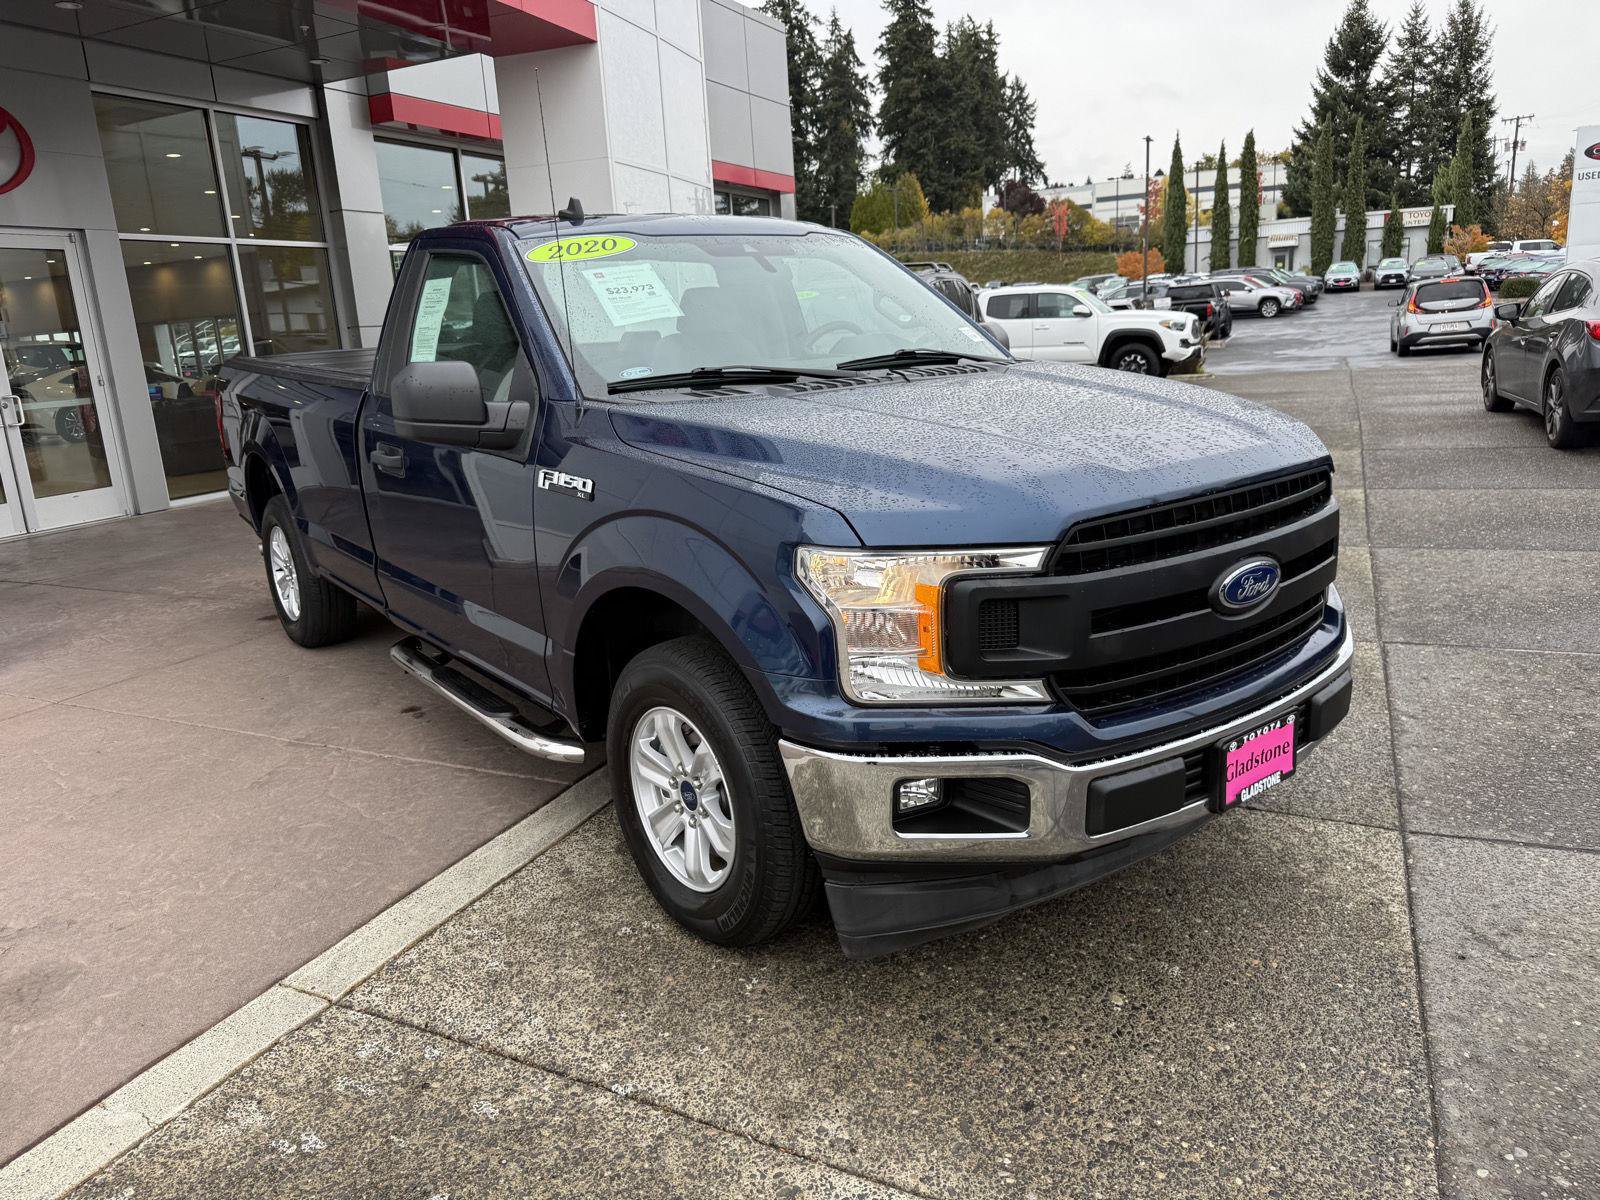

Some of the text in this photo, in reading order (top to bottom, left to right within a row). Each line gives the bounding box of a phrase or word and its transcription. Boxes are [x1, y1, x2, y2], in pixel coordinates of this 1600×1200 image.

[1408, 210, 1433, 219] TOYO
[548, 238, 618, 260] 2020
[577, 491, 586, 499] XL
[1237, 571, 1270, 601] Ford
[1243, 720, 1281, 744] TOYOTA
[1226, 740, 1291, 783] Gladstone
[1240, 771, 1281, 802] GLADSTONE
